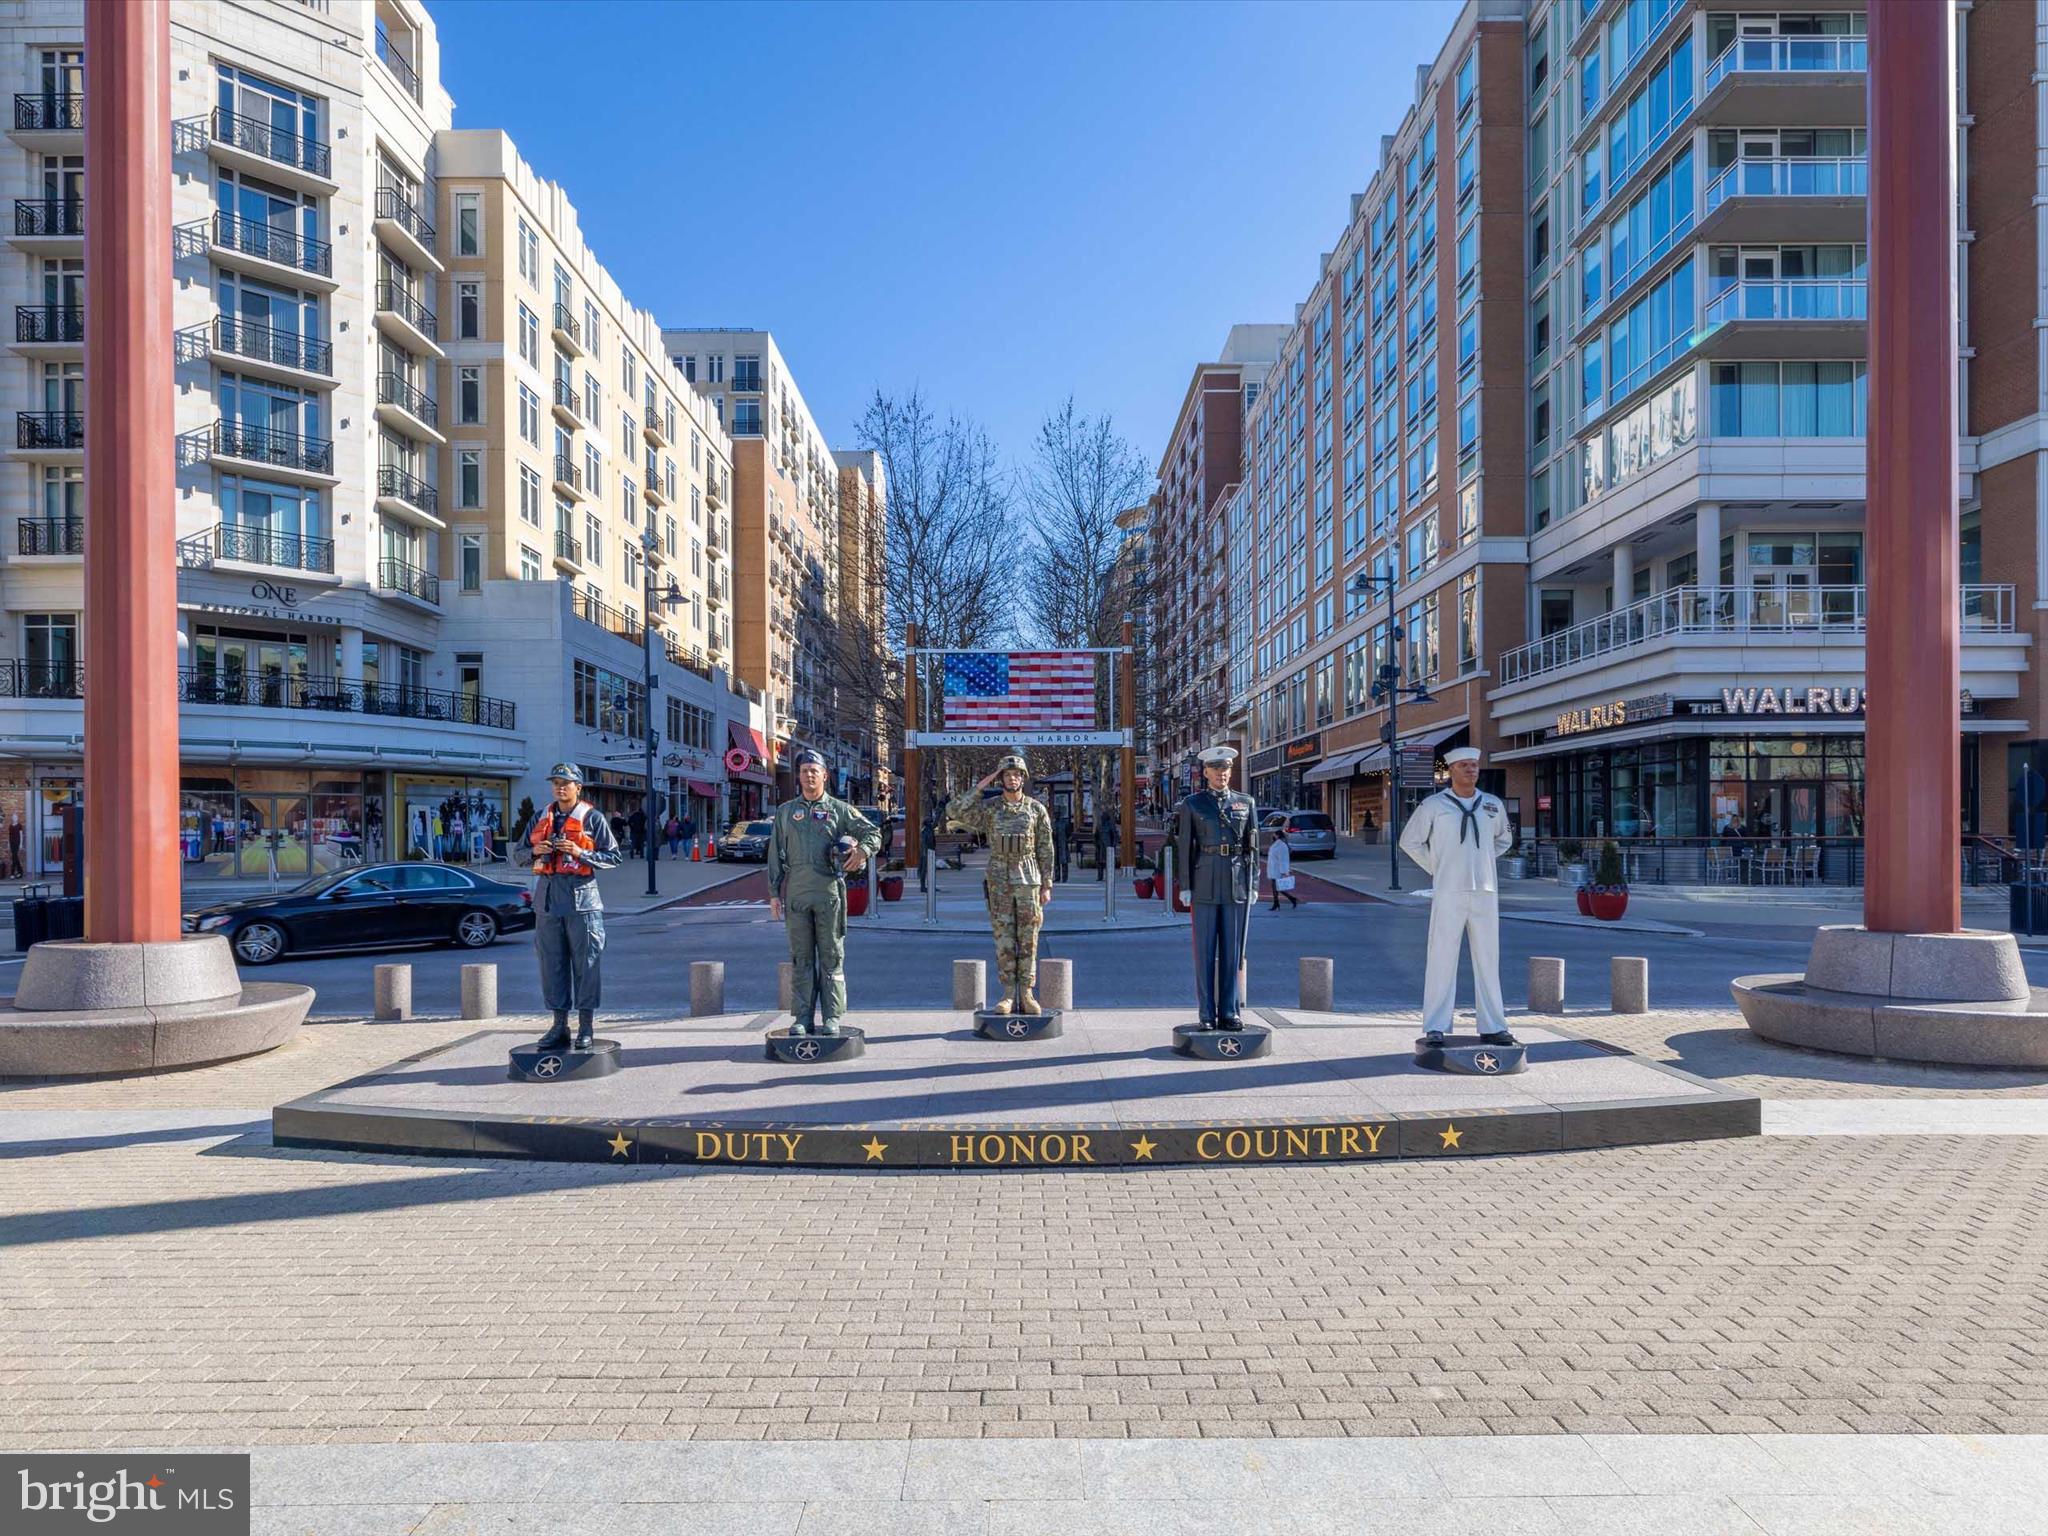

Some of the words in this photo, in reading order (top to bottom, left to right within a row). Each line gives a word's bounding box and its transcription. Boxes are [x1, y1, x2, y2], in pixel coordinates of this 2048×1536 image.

[252, 580, 298, 607] ONE
[201, 602, 279, 618] NATIONAL
[287, 612, 343, 624] HARBOR
[1689, 703, 1722, 715] THE
[1721, 687, 1866, 714] WALRU
[1557, 699, 1626, 736] WALRUS
[950, 735, 1018, 743] NATIONAL
[1037, 734, 1090, 743] HARBOR
[761, 1122, 871, 1131] TEAM
[900, 1121, 1178, 1132] PROTECTING
[1195, 1117, 1307, 1128] YOUR
[696, 1132, 803, 1162] DUTY
[950, 1134, 1095, 1163] HONOR
[1197, 1125, 1387, 1160] COUNTRY
